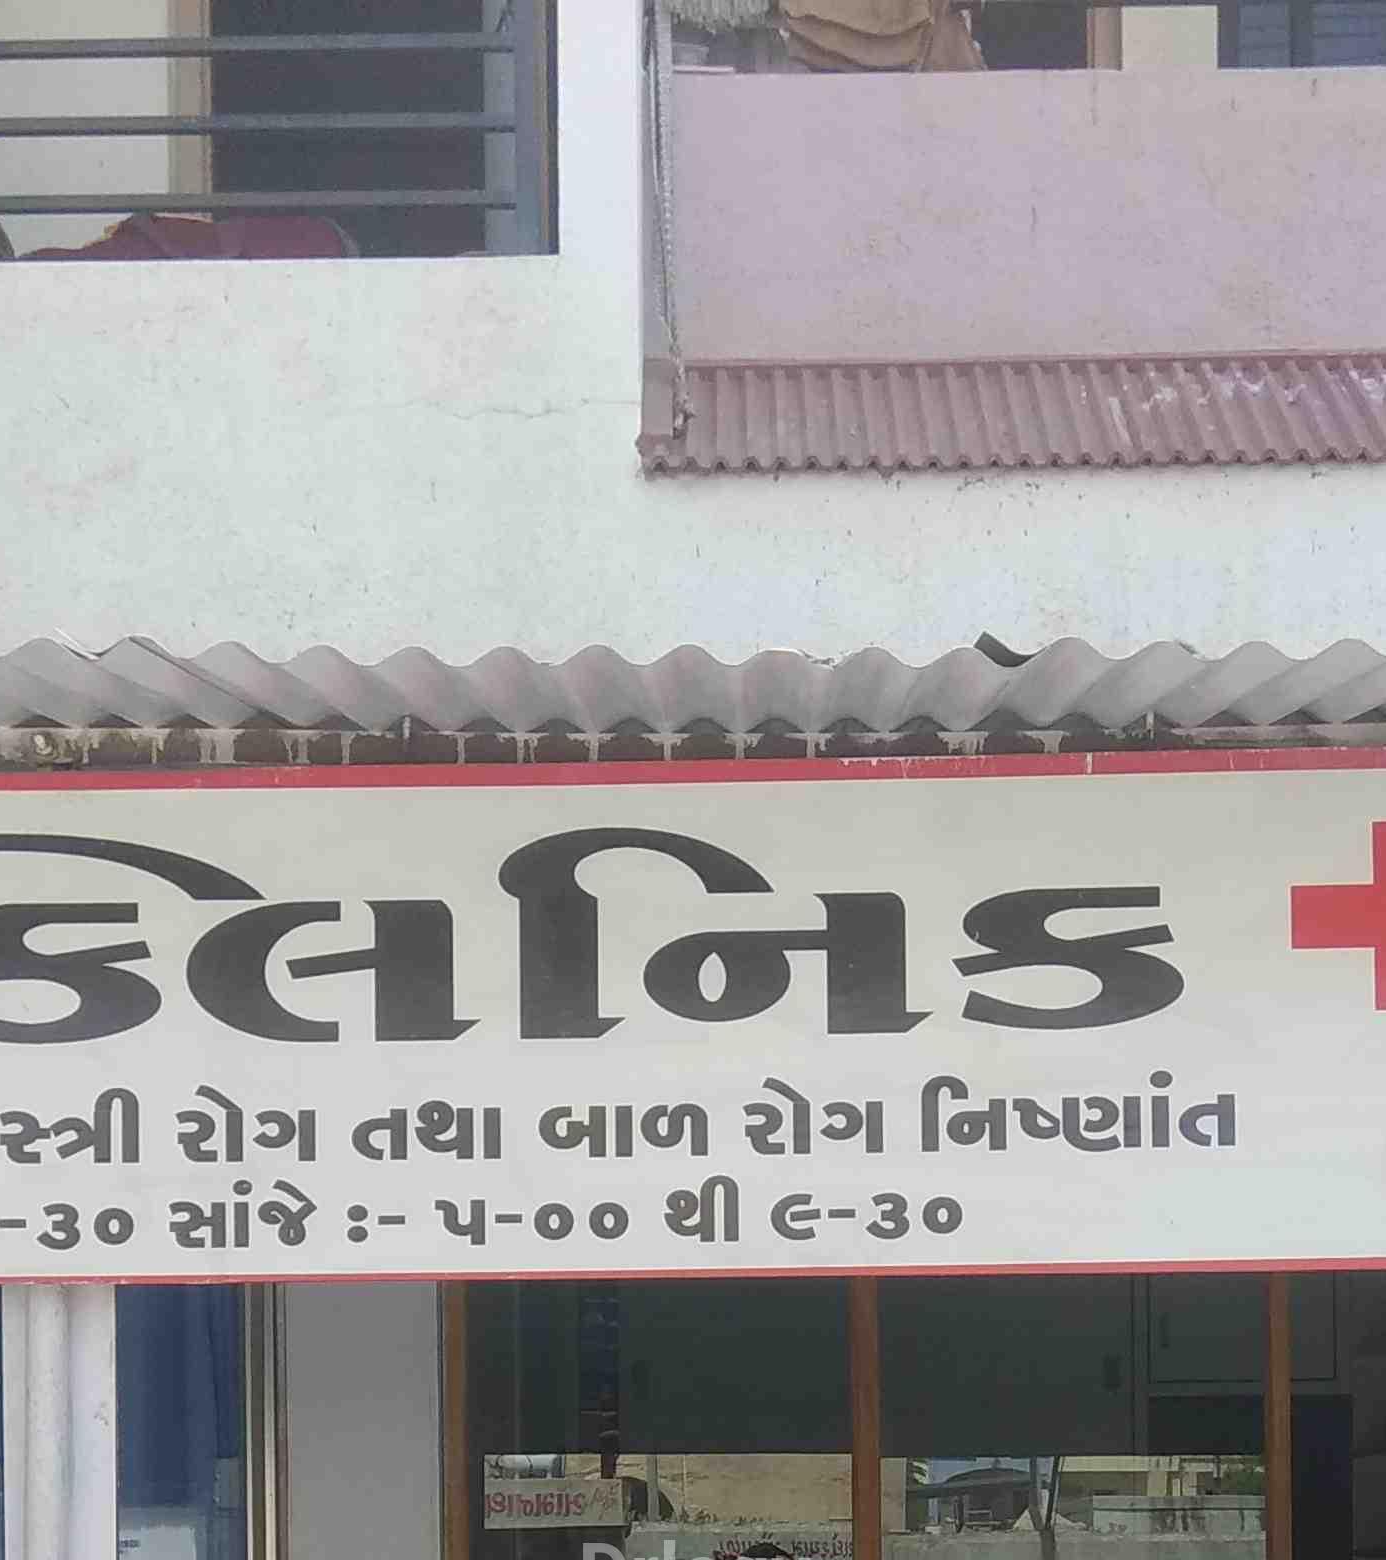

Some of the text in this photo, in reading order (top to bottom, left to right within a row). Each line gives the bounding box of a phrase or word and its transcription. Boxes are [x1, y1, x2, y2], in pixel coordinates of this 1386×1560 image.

[0, 1087, 140, 1164] સ્ત્રી
[176, 1085, 316, 1163] રોગ
[351, 1100, 502, 1161] તથા
[538, 1103, 708, 1158] બાળ
[743, 1077, 884, 1155] રોગ
[921, 1070, 1236, 1153] નિષ્ણાંત
[169, 1179, 318, 1249] સાંજે
[664, 1175, 739, 1243] થી
